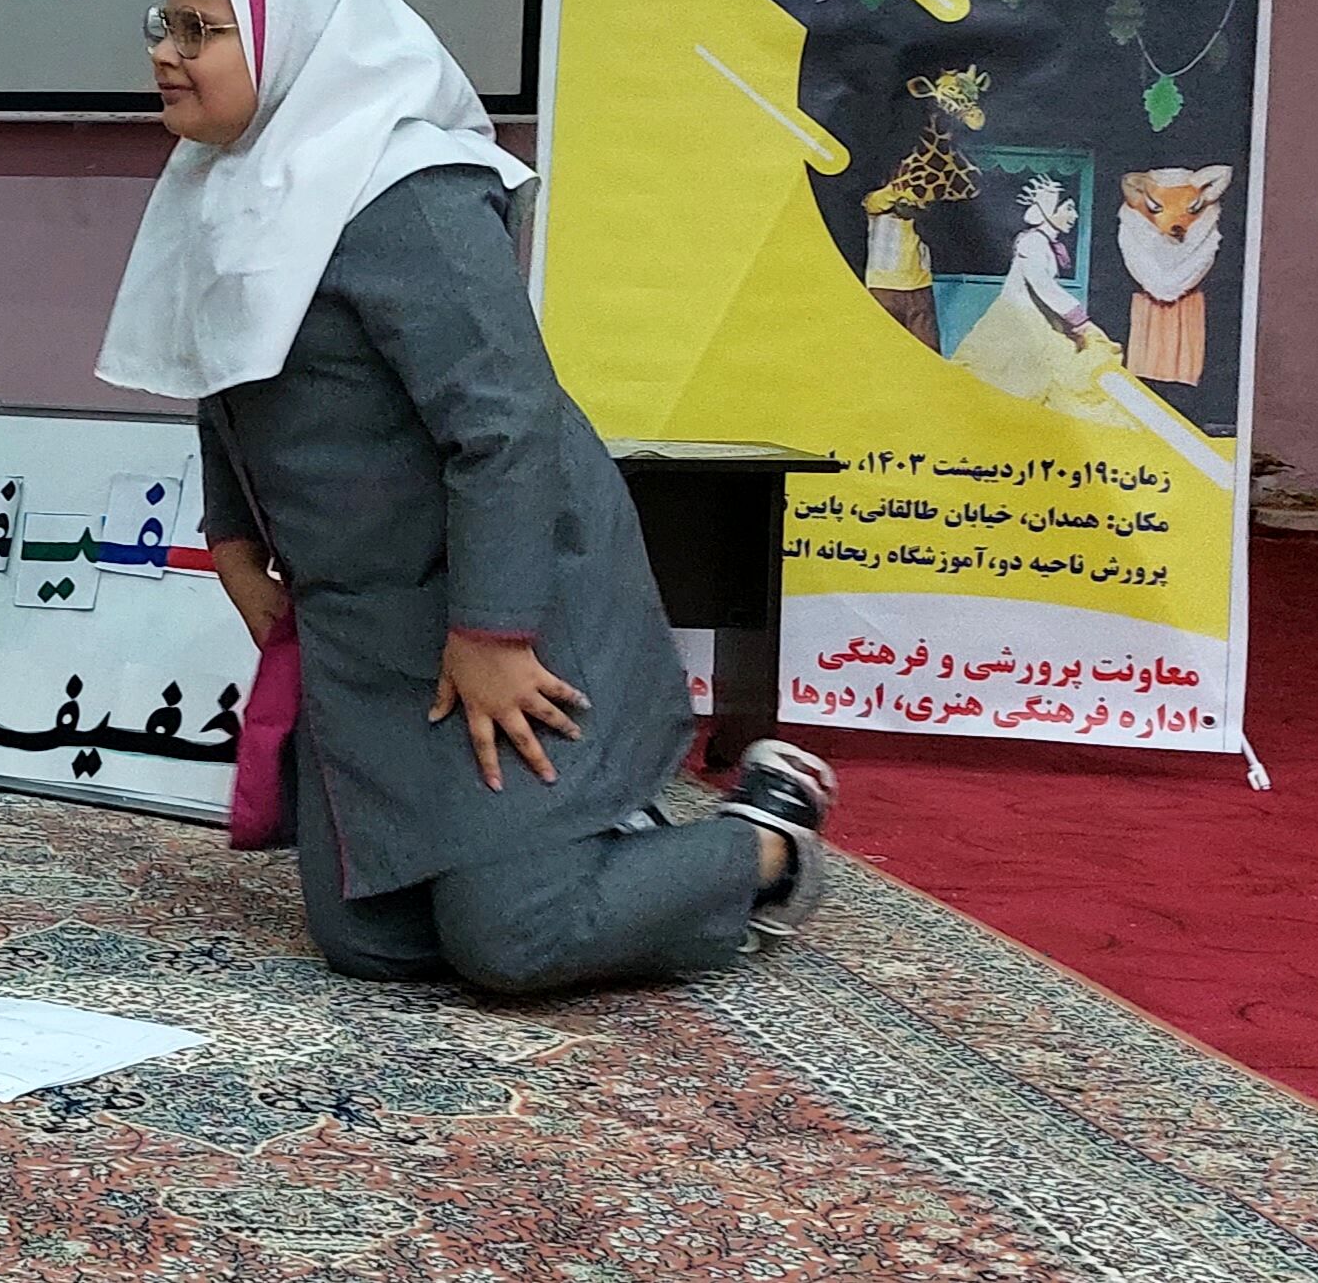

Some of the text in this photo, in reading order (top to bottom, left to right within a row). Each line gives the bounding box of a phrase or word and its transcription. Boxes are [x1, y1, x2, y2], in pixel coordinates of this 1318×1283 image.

[932, 456, 1034, 486] اردیبهشت
[944, 502, 1013, 528] خیابان
[1107, 512, 1169, 536] مکان:
[817, 540, 880, 568] ریحانه
[887, 545, 988, 574] آموزشگاه
[1029, 553, 1084, 578] ناحیه
[1090, 557, 1168, 587] پرورش
[818, 637, 1200, 693] معاونت پرورشی و فرهنگی
[791, 677, 884, 719] اردوها
[993, 696, 1110, 733] فرهنگی
[1118, 706, 1198, 738] اداره
